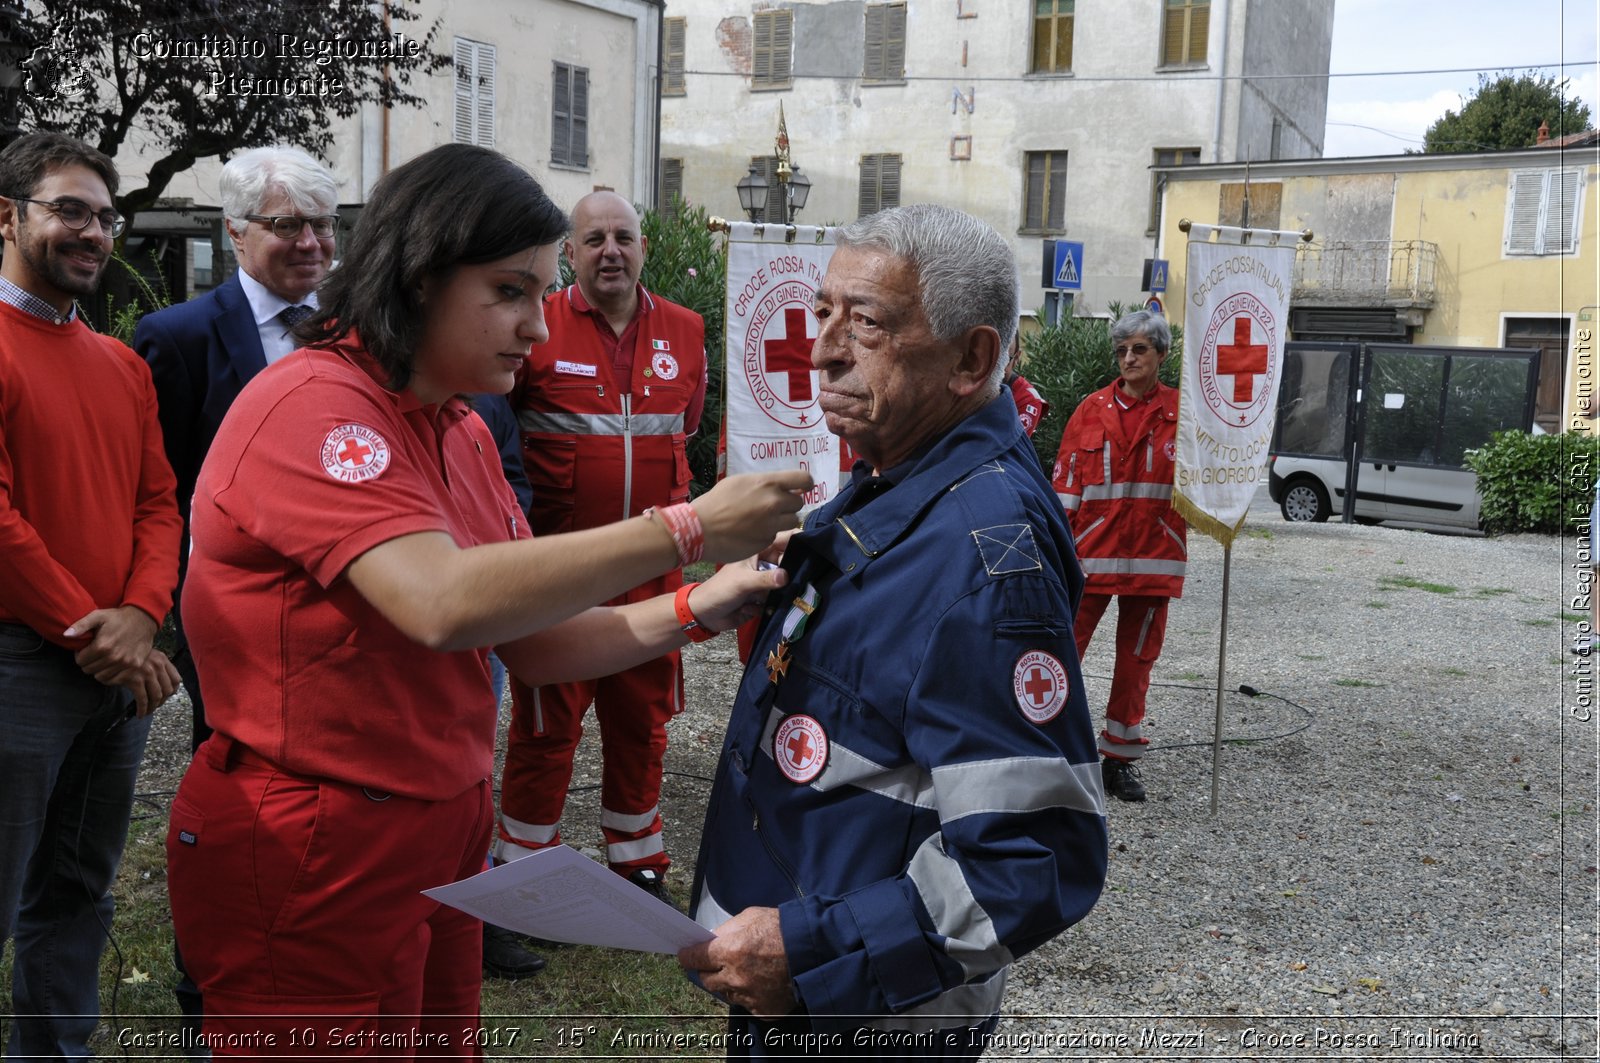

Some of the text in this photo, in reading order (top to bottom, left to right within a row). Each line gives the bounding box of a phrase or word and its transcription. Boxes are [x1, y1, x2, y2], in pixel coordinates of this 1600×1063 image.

[734, 268, 769, 318] CROCE
[769, 255, 805, 278] ROSSA
[1191, 263, 1226, 308] CROCE
[1225, 255, 1256, 276] ROSSA
[747, 285, 814, 410] CONVENZIONE DI GINEVRA
[1201, 316, 1222, 409] CONVENZIONE
[1218, 307, 1229, 321] DI
[1228, 296, 1261, 318] GINEVRA
[1259, 310, 1272, 327] 22
[556, 366, 596, 376] CASTELLAMONTE
[329, 425, 355, 443] ROSSA
[323, 442, 336, 469] CROCE
[750, 439, 809, 461] COMITATO
[340, 458, 385, 482] PIONIERI
[1201, 465, 1257, 485] GIORGIO
[1020, 654, 1040, 669] ROSSA
[1042, 656, 1065, 690] ITALIANA
[778, 723, 791, 745] CROCE
[791, 718, 814, 729] ROSSA
[813, 729, 825, 766] ITALIANA
